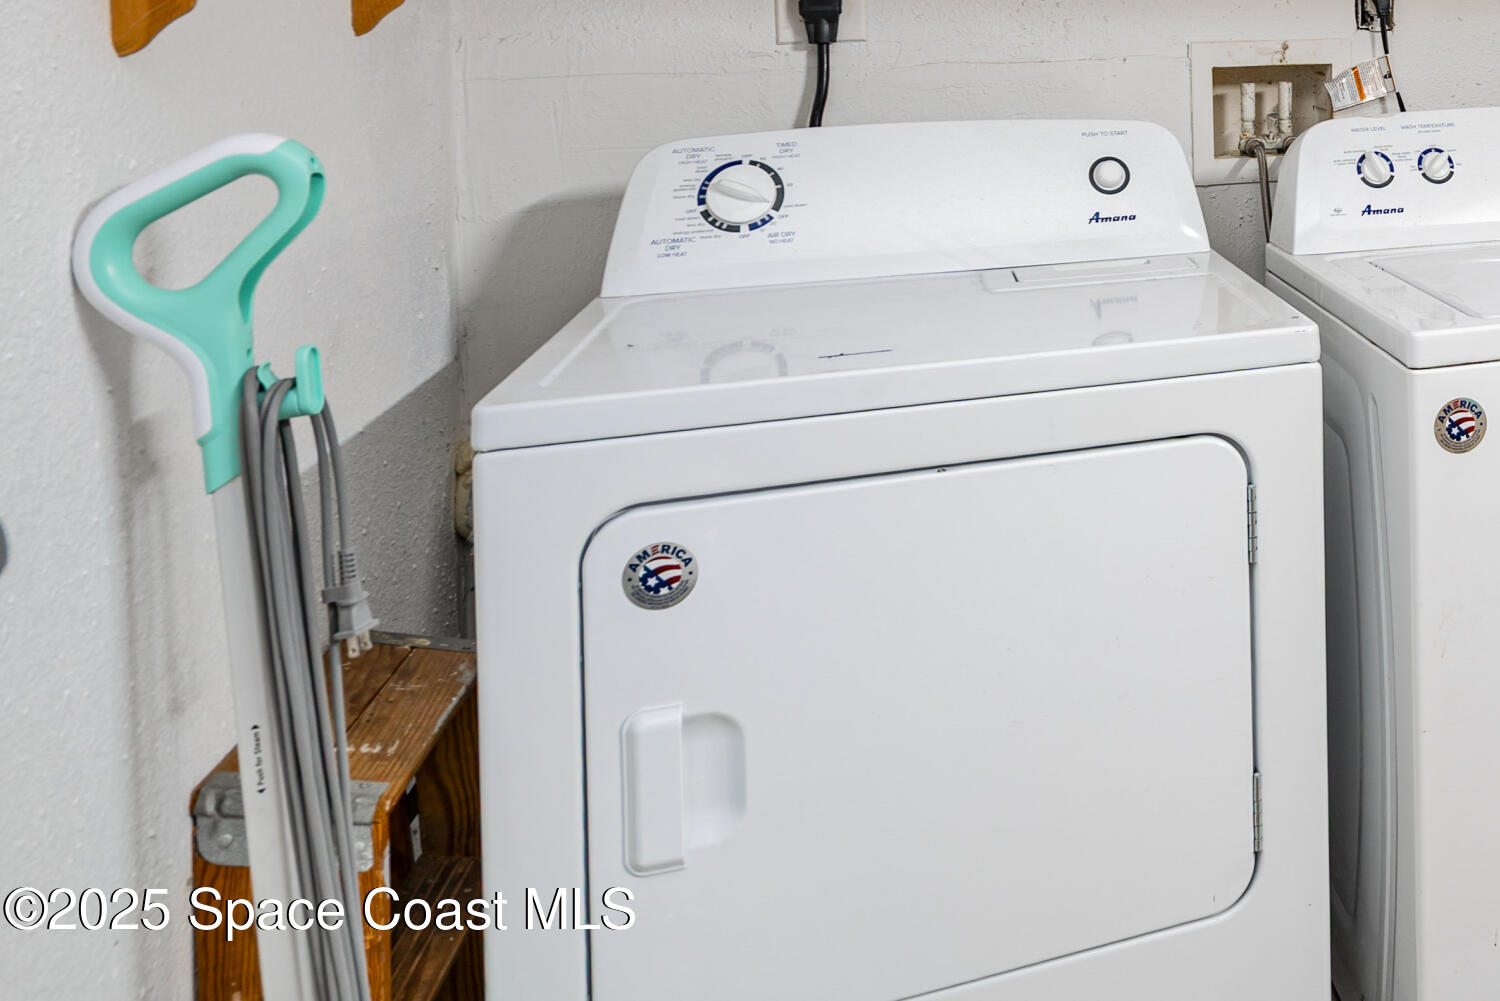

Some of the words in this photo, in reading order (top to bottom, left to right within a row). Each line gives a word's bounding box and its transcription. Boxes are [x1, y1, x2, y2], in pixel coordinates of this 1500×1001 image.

[672, 146, 716, 154] AUTOMATIC
[1362, 204, 1404, 216] Amana
[1088, 212, 1136, 224] Amana
[650, 236, 697, 246] AUTOMATIC
[1438, 400, 1482, 424] AMERICA
[628, 544, 693, 572] AMERICA
